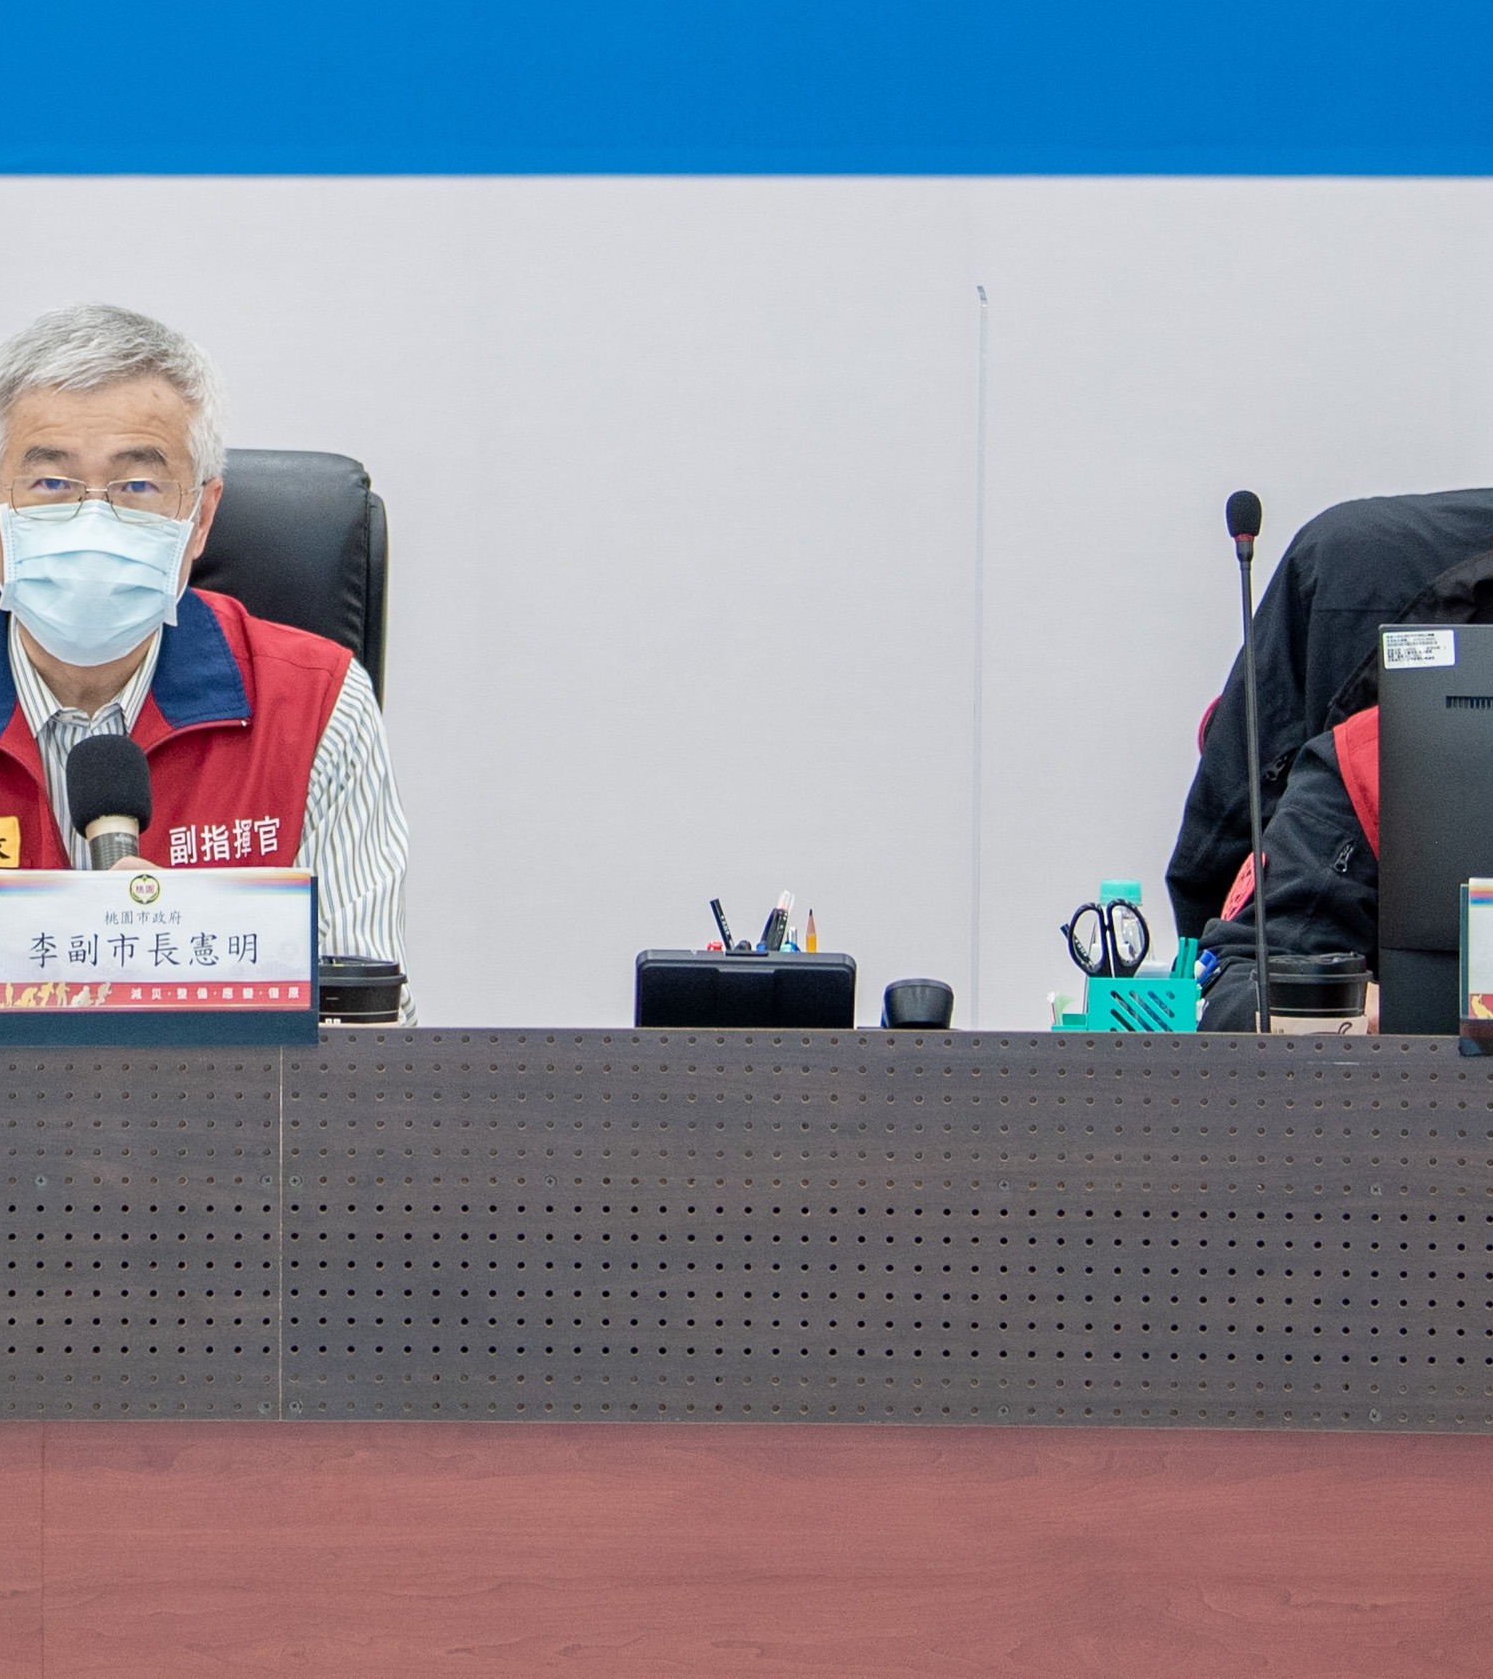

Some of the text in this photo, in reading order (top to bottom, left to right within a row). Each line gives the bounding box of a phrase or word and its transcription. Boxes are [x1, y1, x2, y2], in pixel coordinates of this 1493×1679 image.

[169, 816, 281, 865] 副指揮官
[135, 884, 154, 895] 桃園
[104, 910, 182, 926] 桃園市政府
[29, 931, 259, 969] 李副市長憲明
